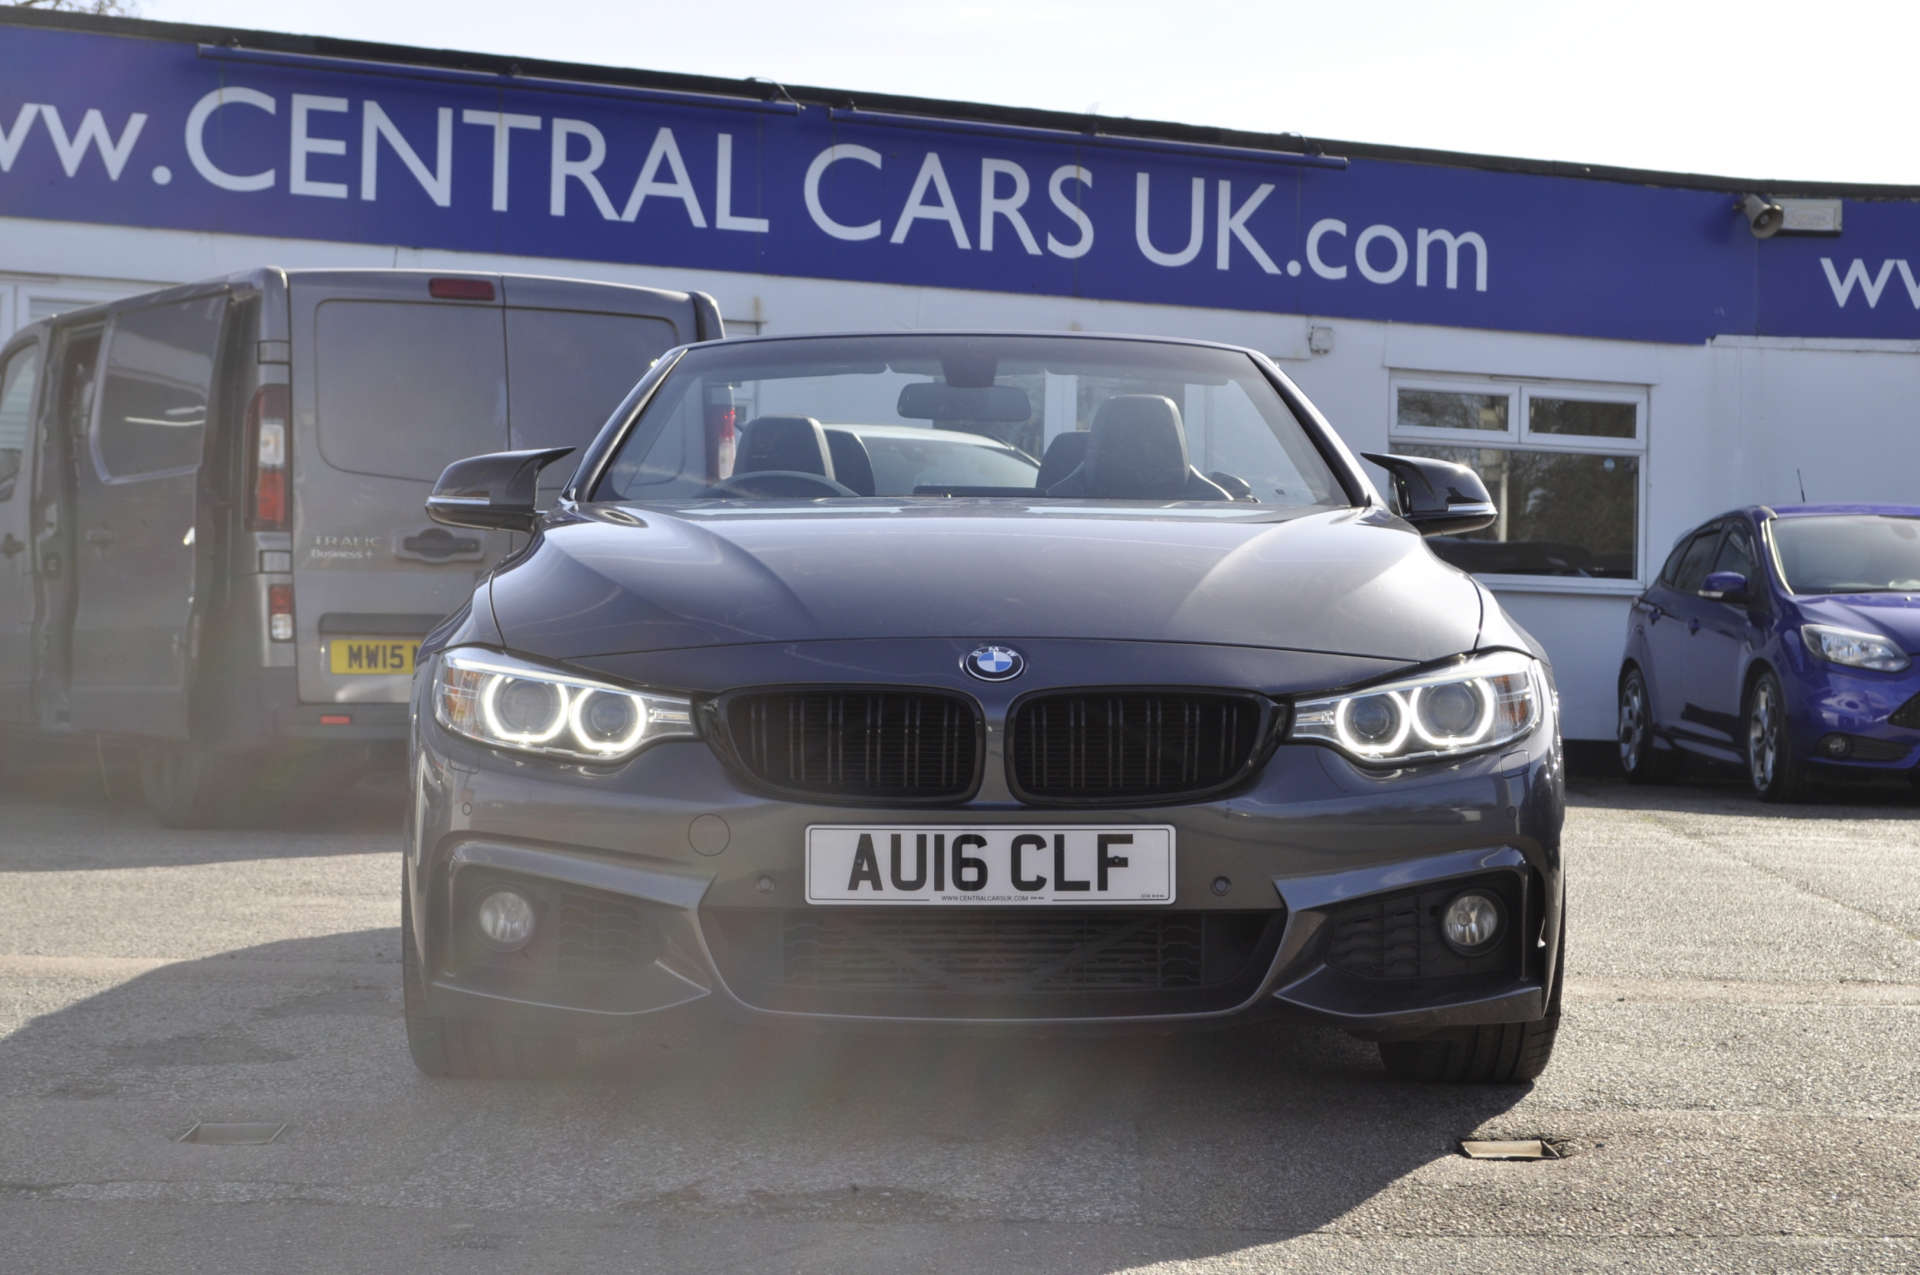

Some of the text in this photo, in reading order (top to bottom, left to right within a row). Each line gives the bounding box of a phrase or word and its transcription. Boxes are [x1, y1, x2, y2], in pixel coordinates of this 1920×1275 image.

[804, 143, 1094, 258] CARS
[1135, 171, 1488, 292] UK.com
[347, 644, 404, 670] MW15
[847, 833, 1134, 892] AU16 CLF
